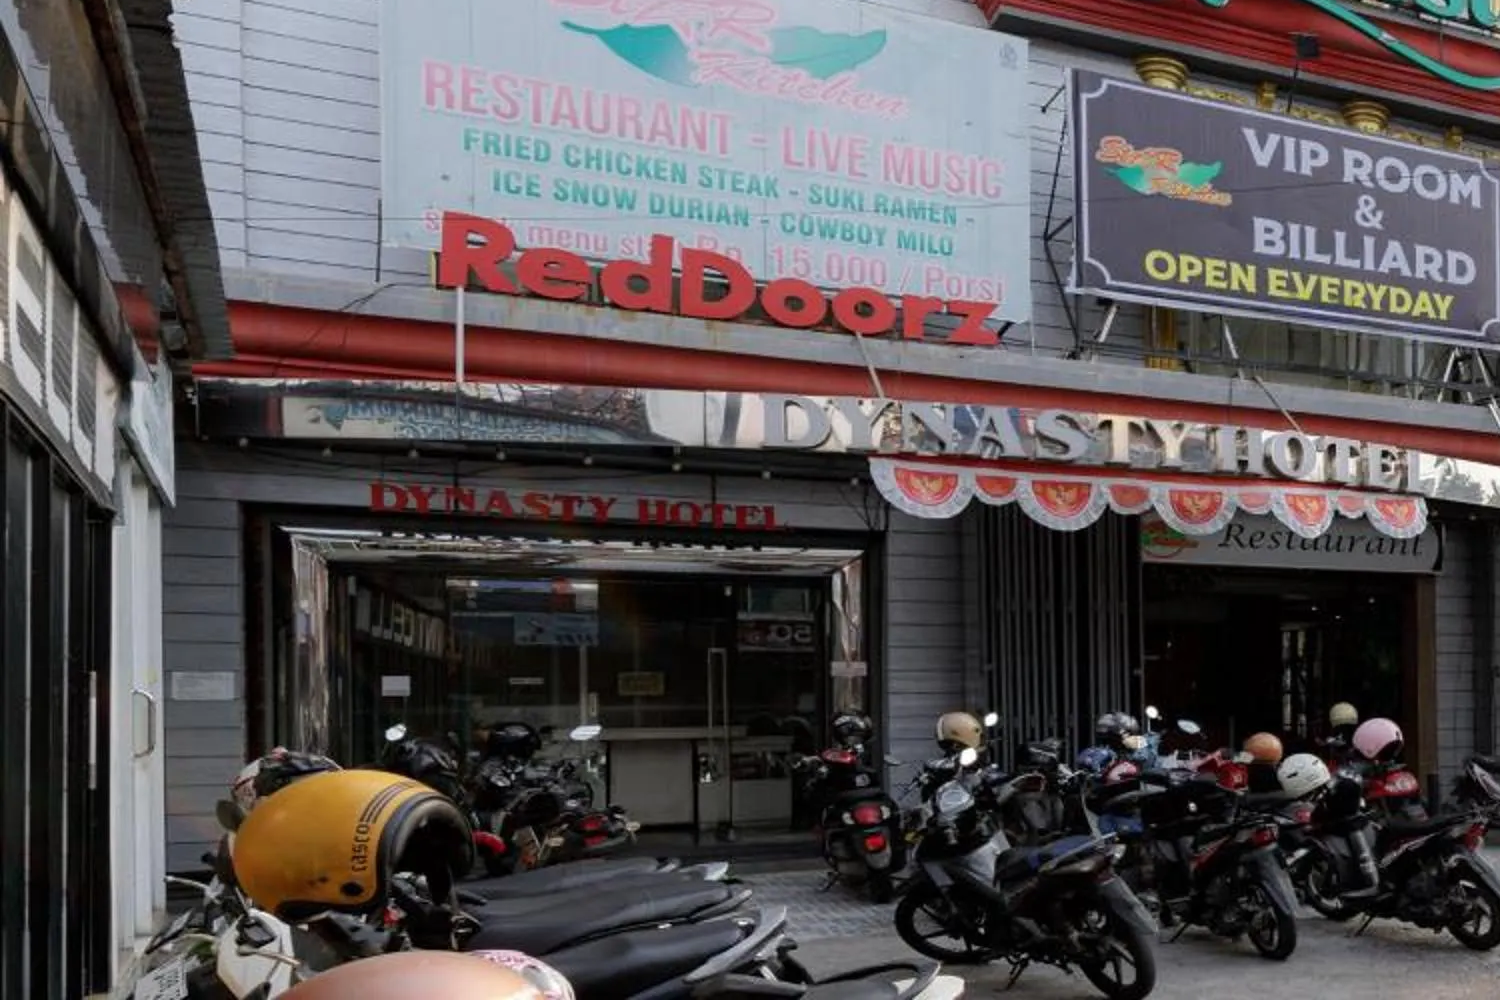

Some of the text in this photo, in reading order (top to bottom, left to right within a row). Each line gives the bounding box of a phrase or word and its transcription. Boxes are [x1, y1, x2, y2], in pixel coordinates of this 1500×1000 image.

[422, 60, 732, 157] RESTAURANT
[782, 126, 868, 179] LIVE
[883, 143, 1003, 199] MUSIC
[463, 127, 551, 164] FRIED
[563, 143, 687, 185] CHICKEN
[698, 164, 780, 199] STEAK
[809, 182, 864, 213] SUKI
[873, 194, 958, 227] RAMEN
[1242, 127, 1482, 209] VIP ROOM
[493, 169, 543, 200] ICE
[553, 177, 637, 212] SNOW
[650, 195, 750, 228] DURIAN
[780, 210, 886, 248] COWBOY
[897, 230, 954, 258] MILO
[1354, 194, 1384, 229] &
[436, 210, 1001, 347] RedDoorz
[526, 224, 608, 252] menu
[770, 246, 888, 288] 15.000
[1144, 249, 1455, 321] OPEN EVERYDAY
[1252, 216, 1477, 285] BILLIARD
[760, 393, 1188, 472] DYNASTY
[1215, 420, 1421, 492] HOTEL
[369, 480, 777, 531] DYNASTY HOTEL
